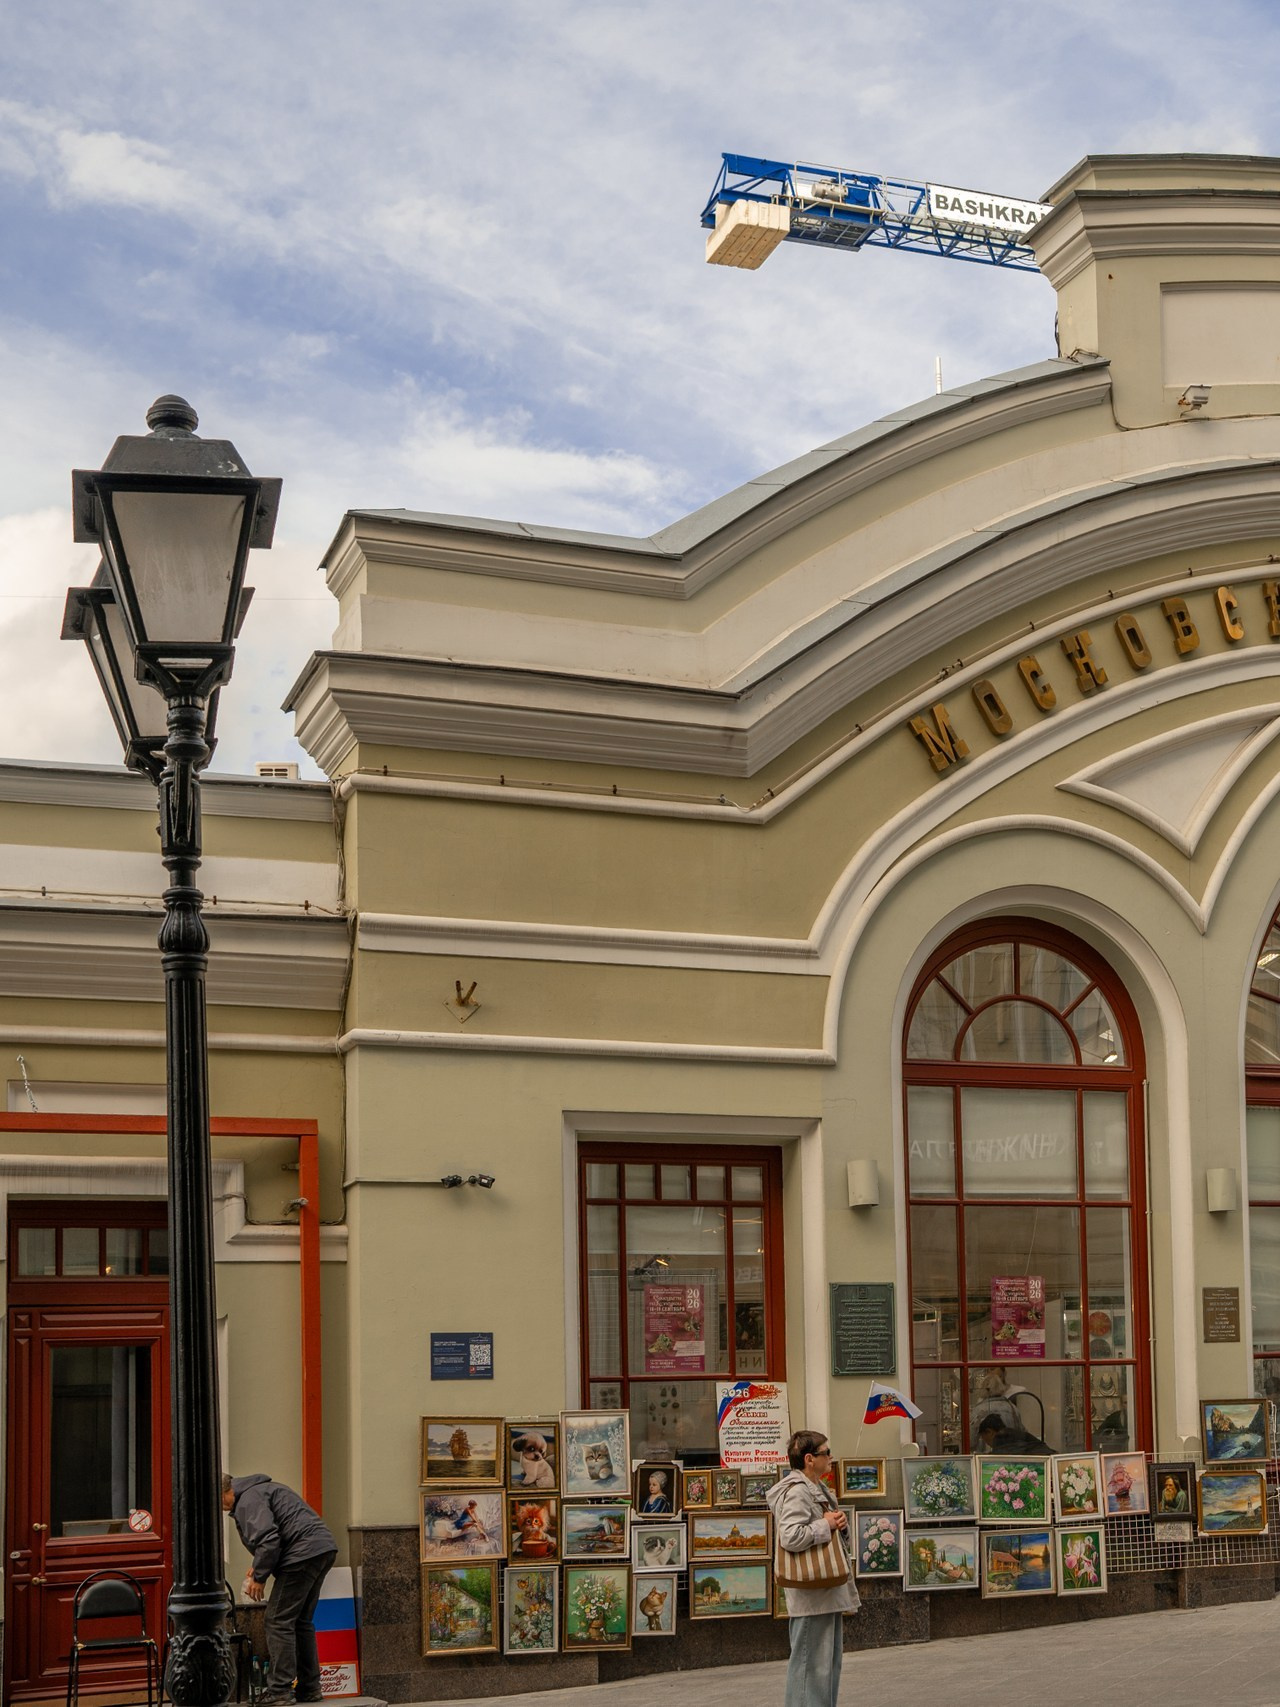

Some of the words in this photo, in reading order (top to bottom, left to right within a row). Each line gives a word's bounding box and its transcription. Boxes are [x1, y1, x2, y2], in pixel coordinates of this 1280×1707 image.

[1029, 1279, 1041, 1289] 20
[687, 1288, 700, 1298] 20
[1029, 1289, 1041, 1299] 26
[687, 1299, 700, 1309] 26
[721, 1387, 750, 1398] 2026
